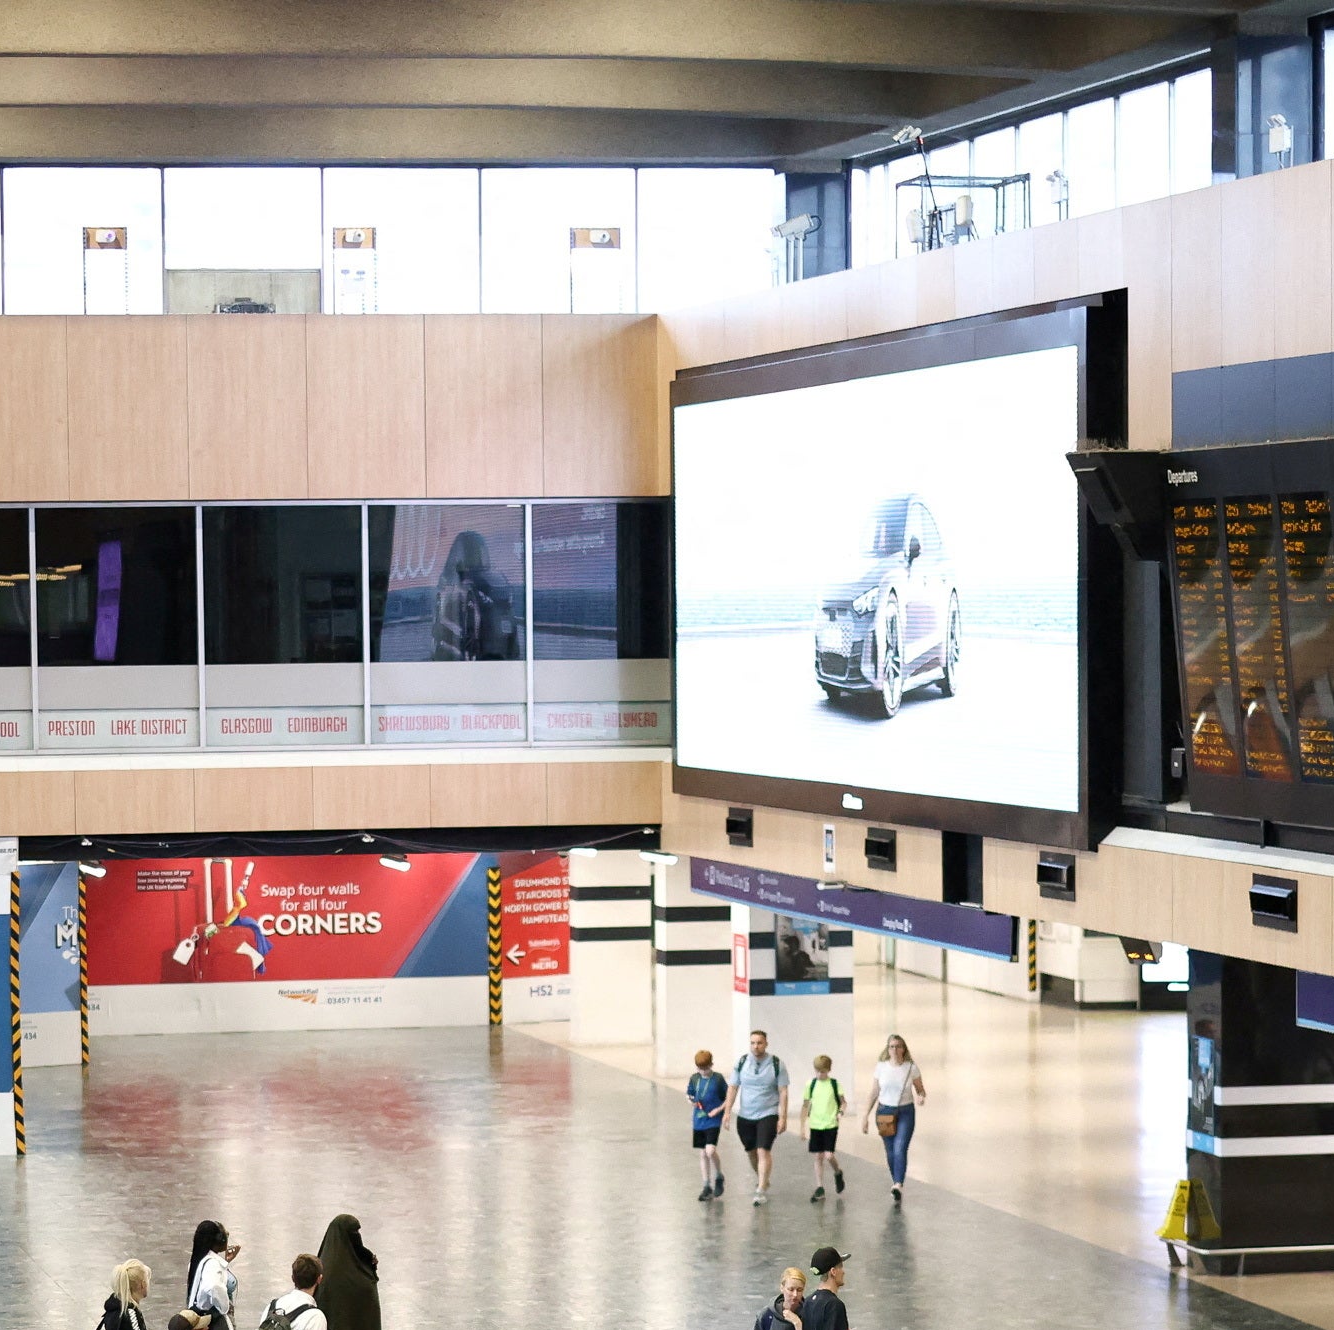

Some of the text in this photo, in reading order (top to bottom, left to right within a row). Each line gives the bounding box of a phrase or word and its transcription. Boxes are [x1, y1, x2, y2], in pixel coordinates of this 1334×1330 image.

[1167, 468, 1198, 487] Departures
[48, 718, 188, 736] PRESTON LAKE DISTRICT
[221, 716, 348, 734] GLASGOW EDINBURGH
[378, 714, 522, 732] SHREWSBURY BLACKPOOL
[547, 711, 658, 729] CHESTER HOLYHEAD
[261, 882, 360, 900] Swap four walls
[514, 877, 560, 888] DRUMMOND
[516, 890, 561, 900] STARCROSS
[281, 898, 347, 911] for all four
[504, 903, 531, 914] NORTH
[533, 902, 562, 912] GOWER
[258, 912, 383, 936] CORNERS
[522, 914, 570, 925] HAMPSTEAD
[530, 985, 553, 997] HS2
